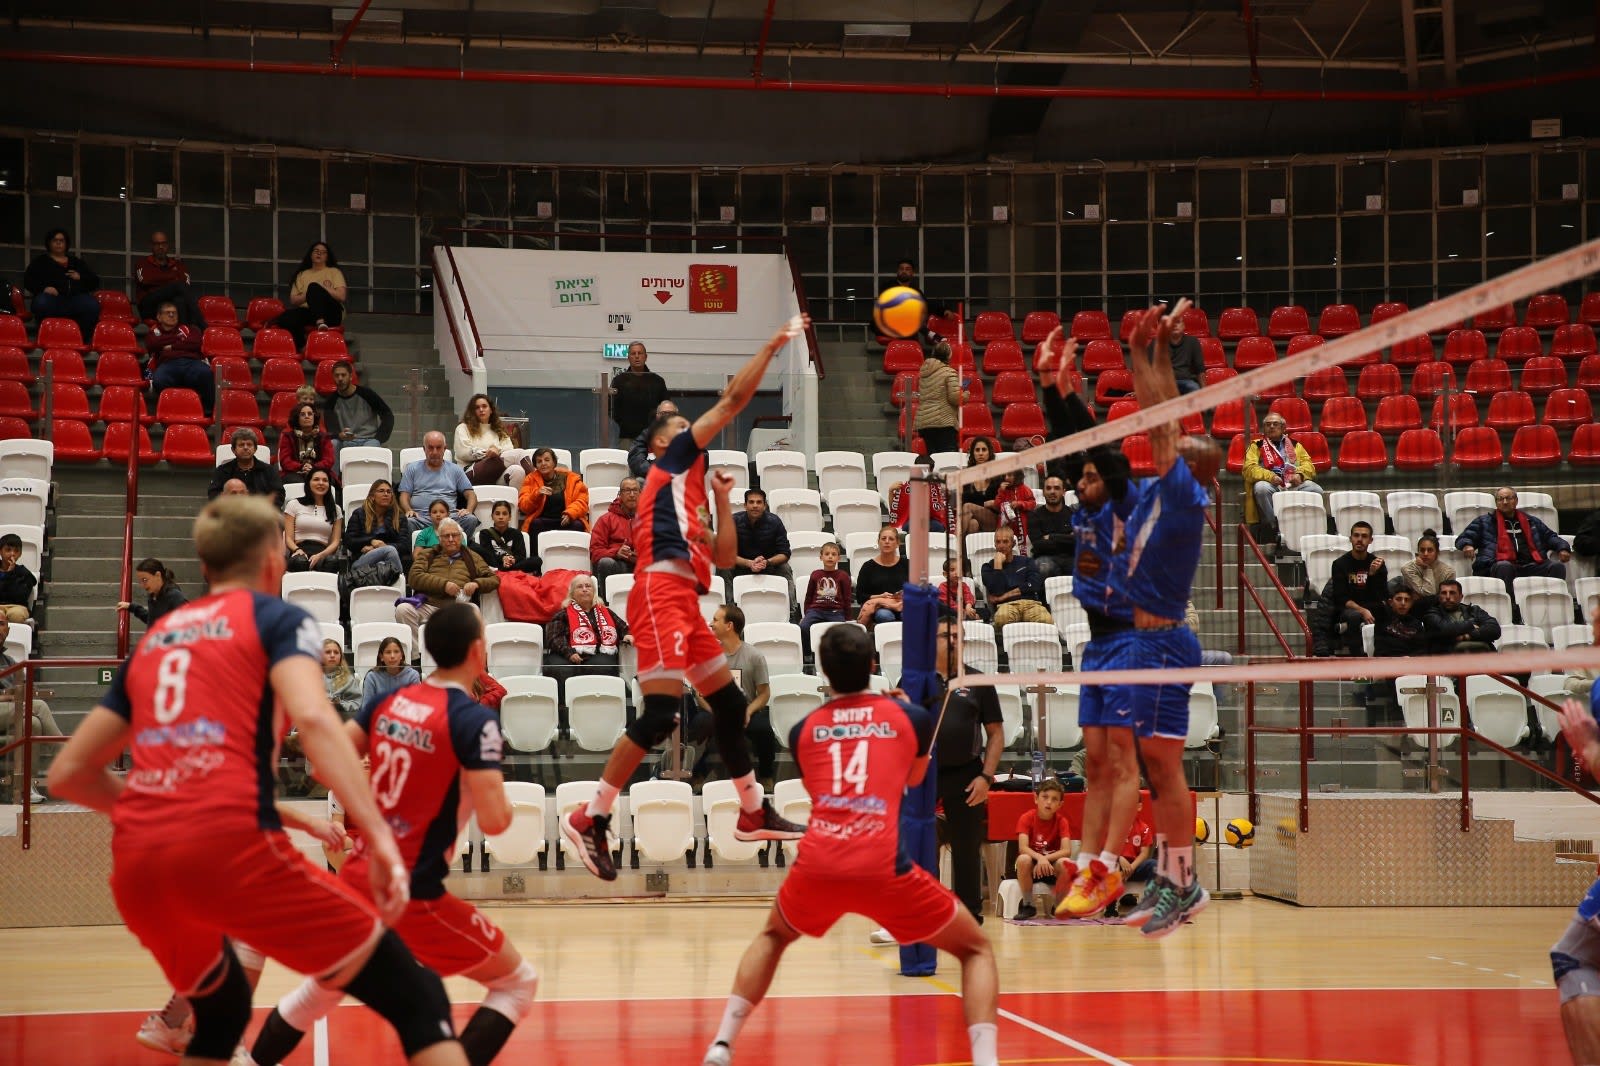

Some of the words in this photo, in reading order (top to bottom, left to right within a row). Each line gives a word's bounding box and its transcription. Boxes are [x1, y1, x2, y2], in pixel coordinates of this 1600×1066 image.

[555, 278, 594, 290] יציאת
[641, 277, 685, 288] שרותים
[559, 292, 592, 303] חרום
[703, 301, 724, 309] טוטו
[673, 631, 685, 657] 2
[102, 670, 113, 682] B
[154, 647, 193, 725] 8
[1443, 710, 1455, 721] A
[375, 714, 436, 754] DORAL
[813, 721, 898, 743] DORAL
[372, 741, 413, 810] 20
[828, 739, 870, 795] 14
